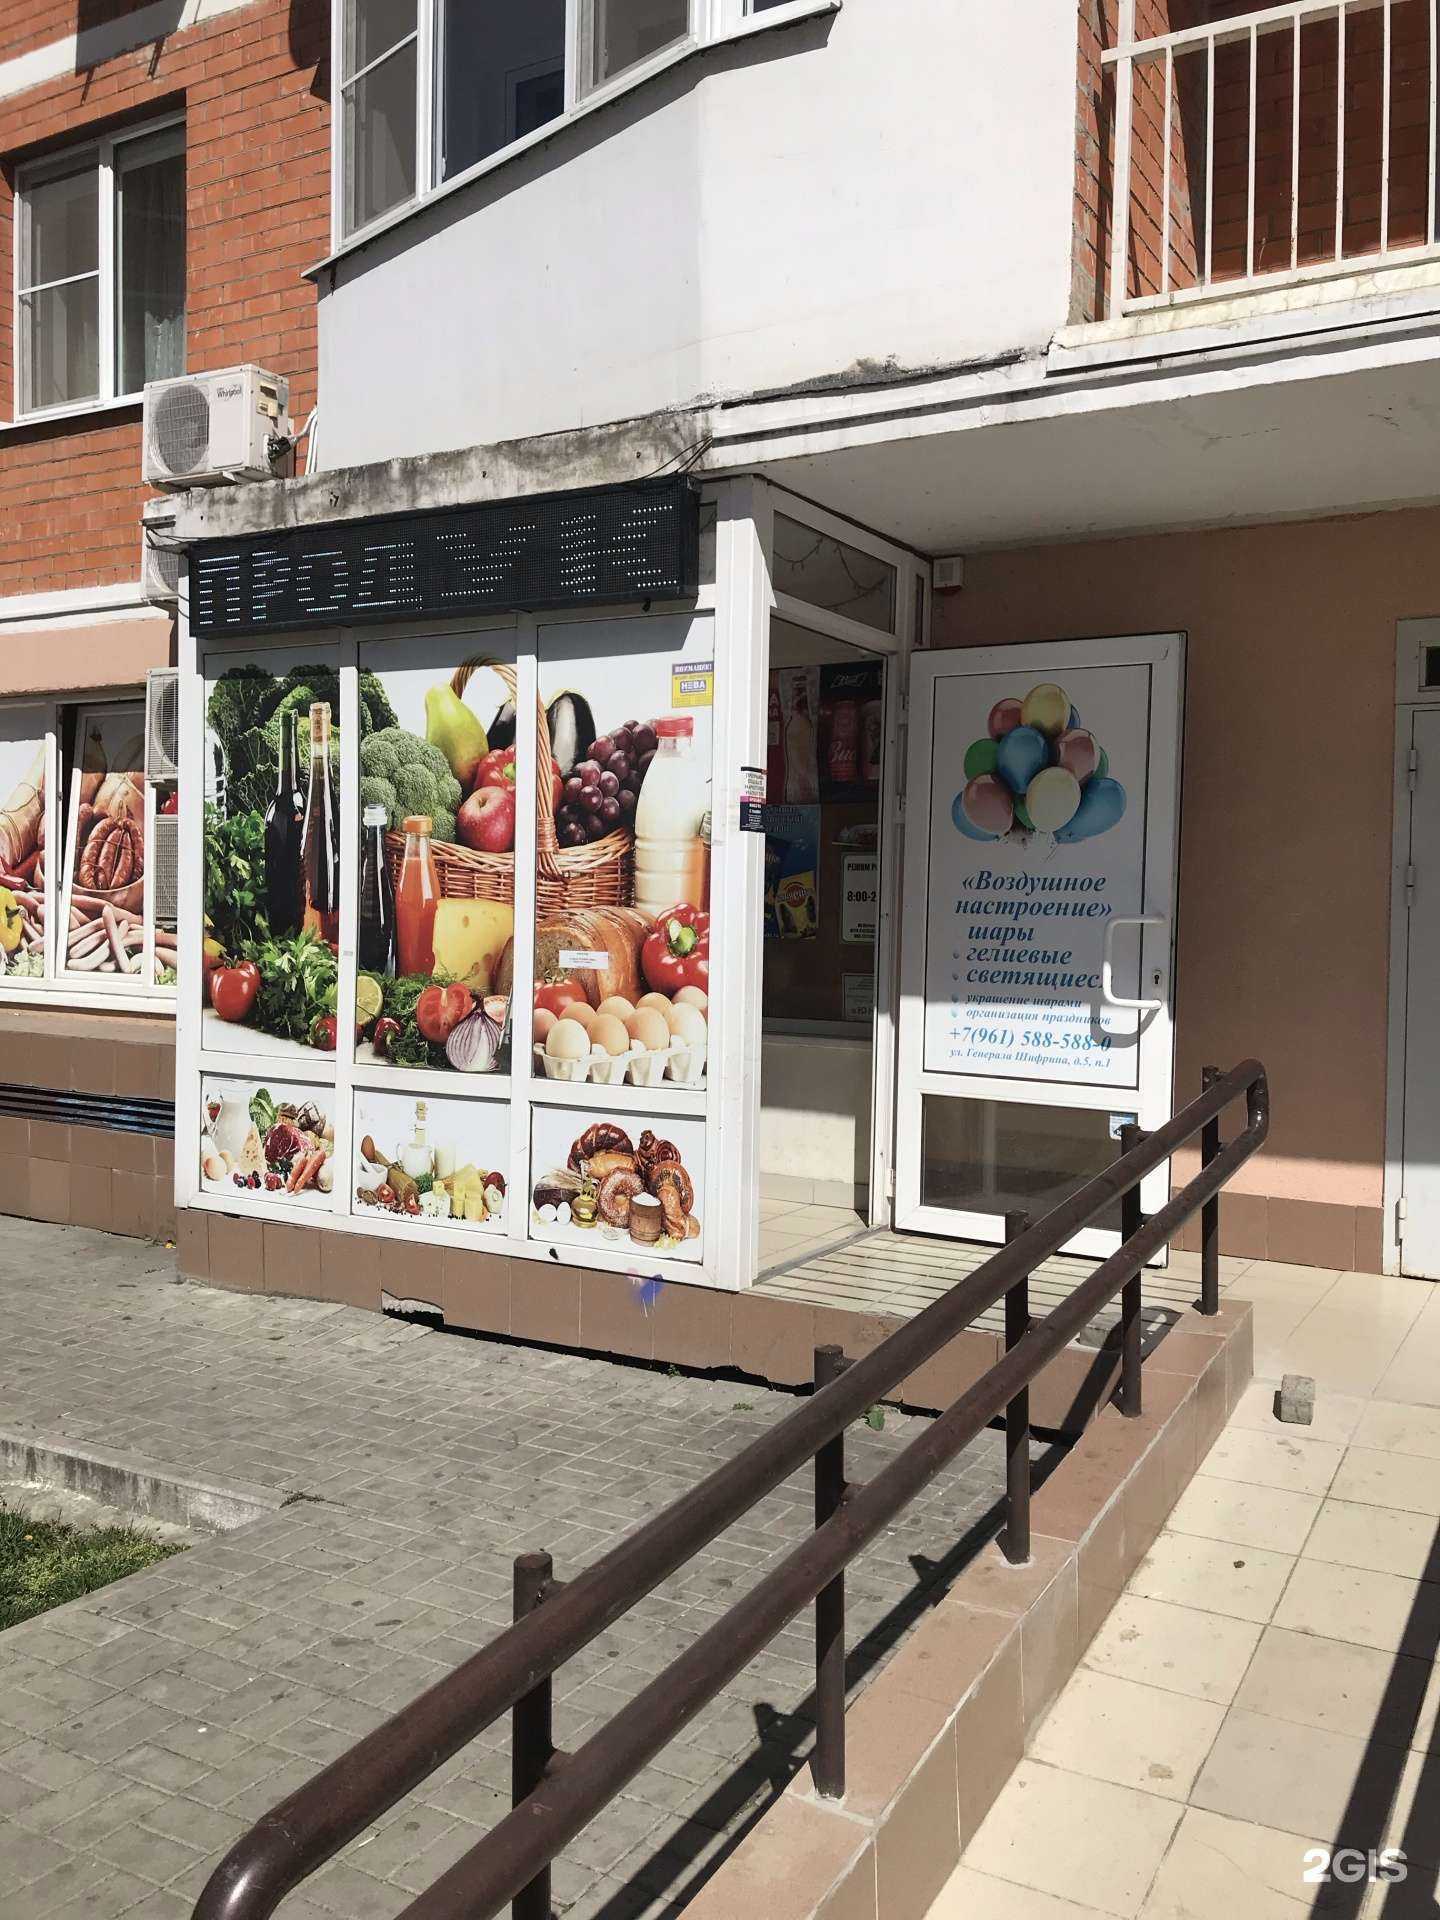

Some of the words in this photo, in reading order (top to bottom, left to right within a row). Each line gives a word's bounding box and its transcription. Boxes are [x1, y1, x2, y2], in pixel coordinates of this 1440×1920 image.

[962, 870, 1106, 896] «Воздушное
[847, 891, 877, 902] 8:00-2
[955, 899, 1112, 920] настроение»
[968, 926, 1035, 946] шары
[966, 947, 1073, 965] гелиевые
[965, 993, 1031, 1007] украшение
[1032, 997, 1082, 1009] шарами
[966, 1008, 1038, 1022] организация
[1042, 1013, 1112, 1026] праздников
[949, 1027, 1015, 1048] +7(961)
[1021, 1031, 1112, 1052] 588-588-0
[949, 1049, 963, 1058] ул.
[966, 1048, 1012, 1061] Генерала
